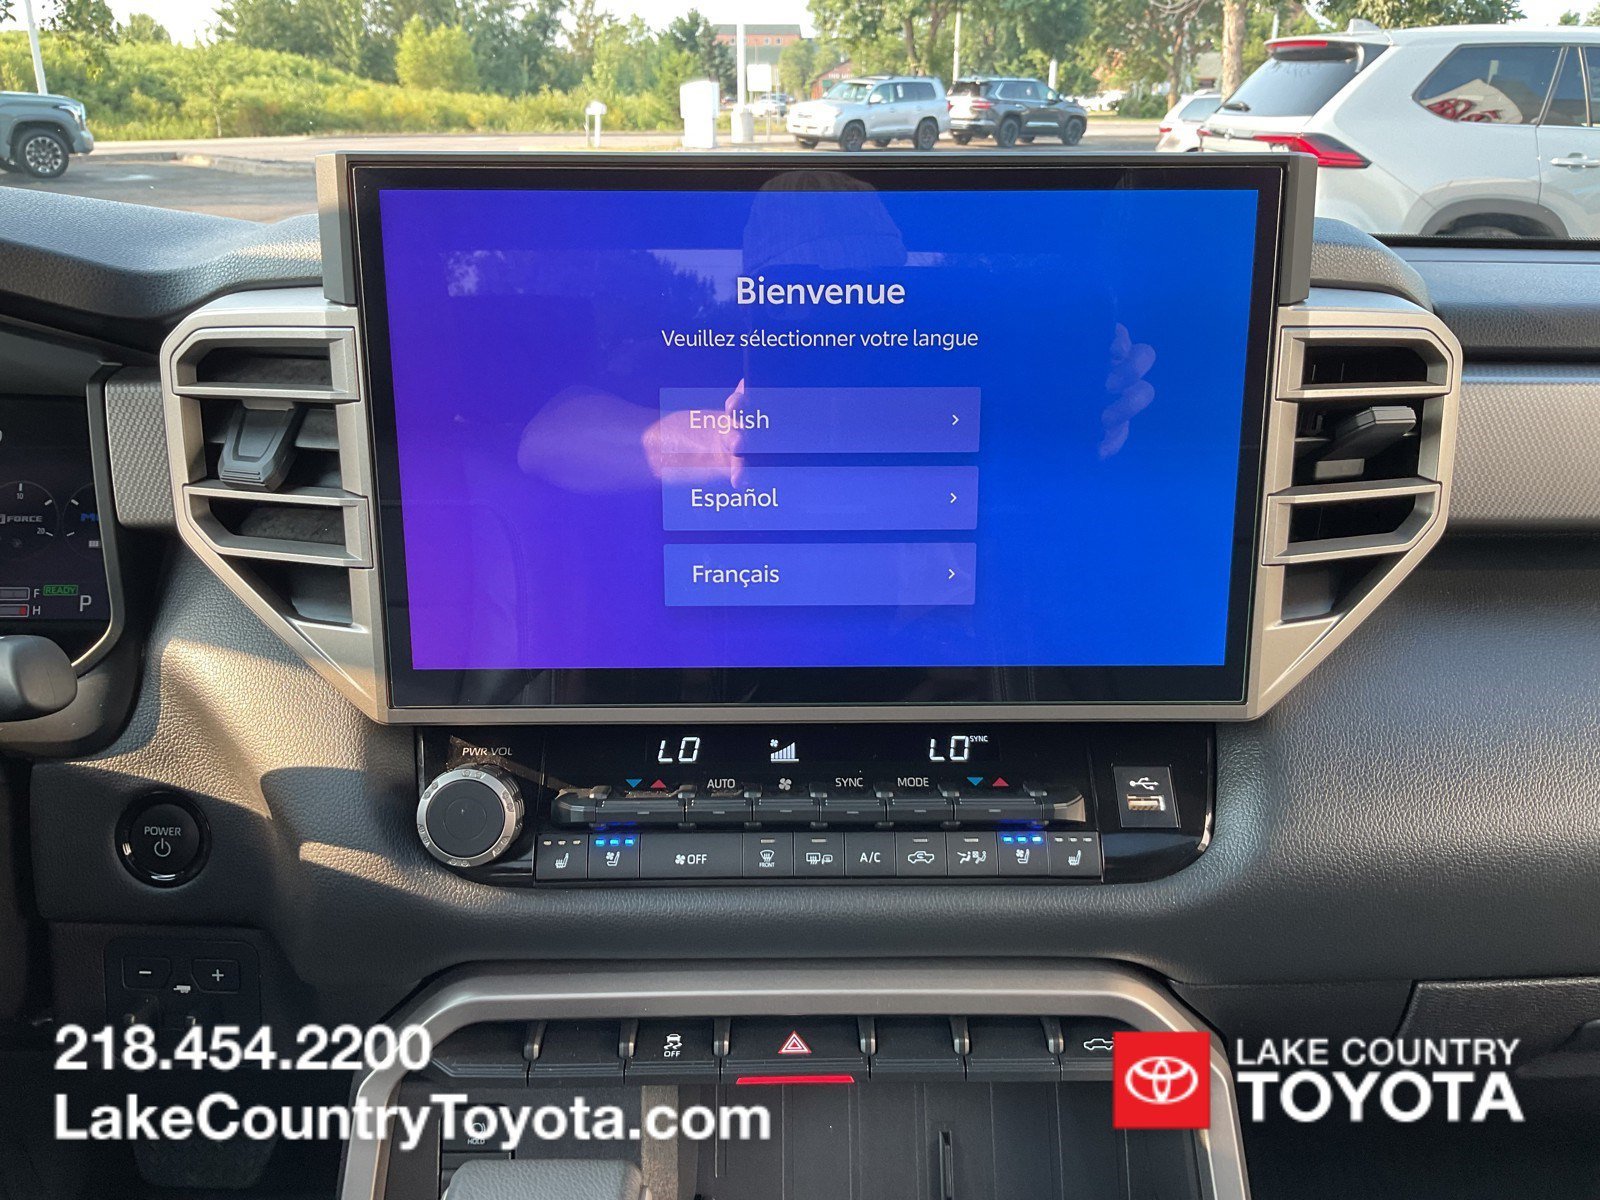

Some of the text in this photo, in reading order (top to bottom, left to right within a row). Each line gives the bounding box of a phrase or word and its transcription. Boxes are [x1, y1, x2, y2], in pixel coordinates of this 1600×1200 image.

[736, 275, 906, 306] Bienvenue
[661, 328, 979, 351] Veuillez sélectionner votre langue
[689, 409, 770, 434] English
[16, 492, 24, 500] 10
[690, 487, 779, 512] Español
[36, 527, 46, 535] 20
[692, 565, 780, 588] Français
[33, 588, 40, 599] F
[45, 586, 76, 594] READY
[79, 594, 92, 612] P
[32, 605, 41, 615] H
[969, 735, 989, 743] SYNC
[461, 746, 513, 756] PWR VOL
[706, 777, 736, 790] AUTO
[834, 776, 864, 788] SYNC
[896, 776, 929, 788] MODE
[143, 825, 182, 836] POWER
[687, 852, 708, 865] OFF
[859, 851, 881, 864] A/C
[663, 1050, 681, 1058] OFF
